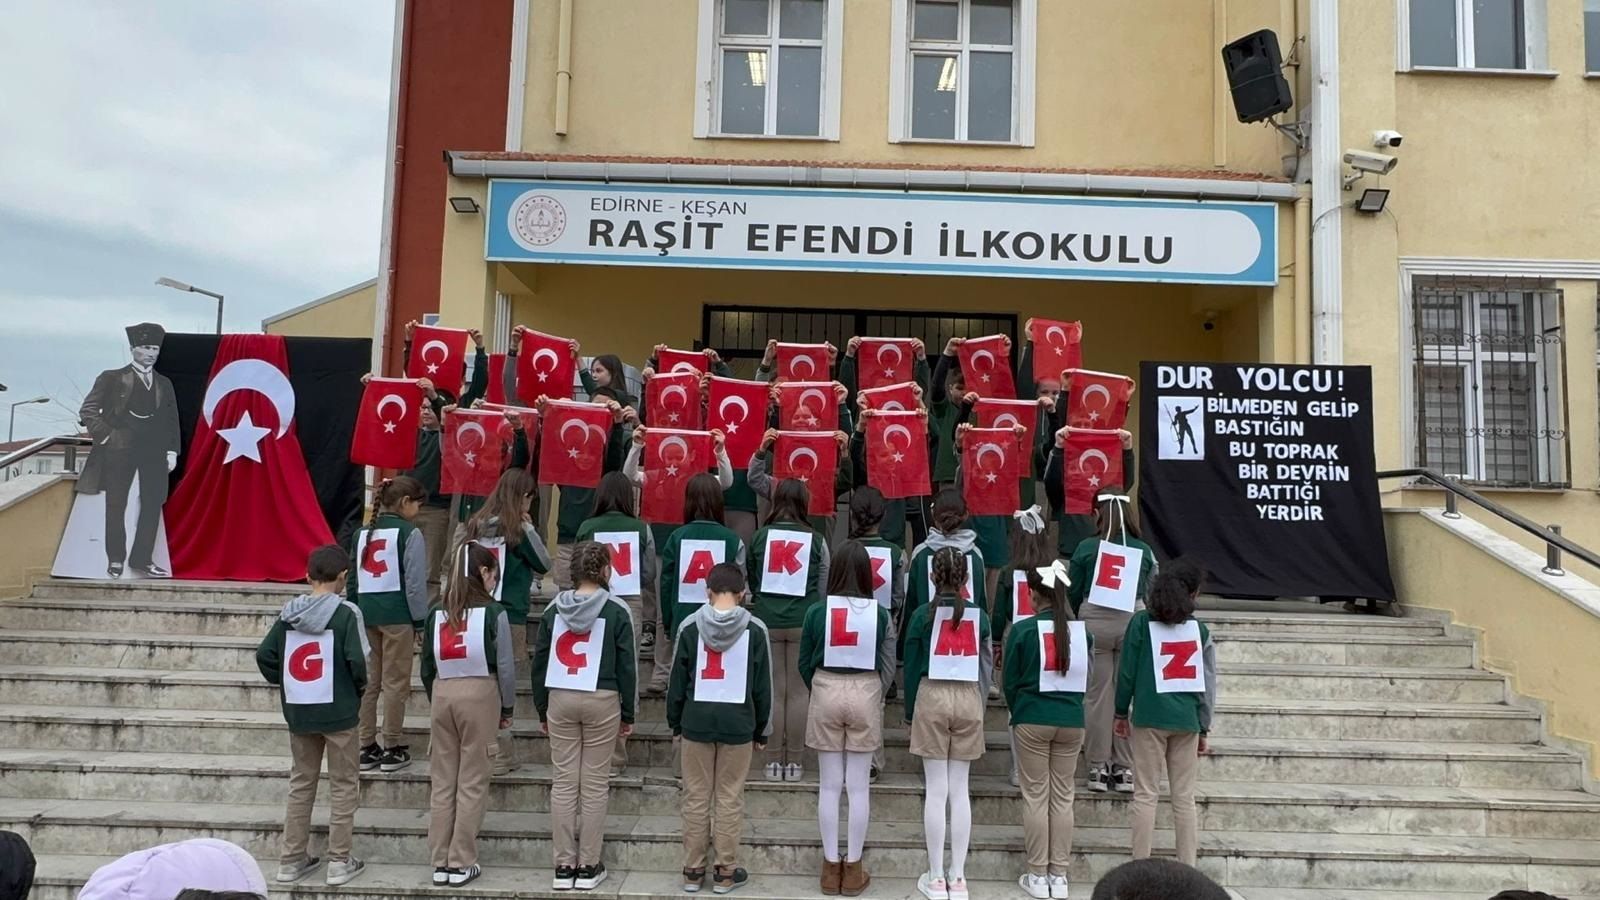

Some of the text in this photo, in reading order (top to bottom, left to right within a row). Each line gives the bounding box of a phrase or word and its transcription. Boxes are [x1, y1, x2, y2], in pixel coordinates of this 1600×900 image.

[590, 196, 663, 213] EDİRNE
[681, 200, 747, 218] KEŞAN
[587, 215, 724, 257] RAŞİT
[746, 220, 913, 255] EFENDİ
[938, 222, 1174, 265] İLKOKULU
[1157, 365, 1214, 391] DUR
[1207, 393, 1360, 418] BİLMEDEN GELİP
[1214, 417, 1305, 437] BASTIĞIN
[1229, 441, 1340, 460] BU TOPRAK
[1238, 460, 1350, 482] BİR DEVRİN
[1246, 481, 1321, 501] BATTIĞI
[1255, 501, 1324, 521] YERDİR
[767, 539, 804, 576] K
[1095, 551, 1126, 590] E
[438, 619, 469, 661] E
[829, 607, 859, 647] L
[933, 619, 979, 657] M
[288, 641, 324, 682] G
[555, 630, 591, 676] Ç
[1159, 640, 1199, 680] Z
